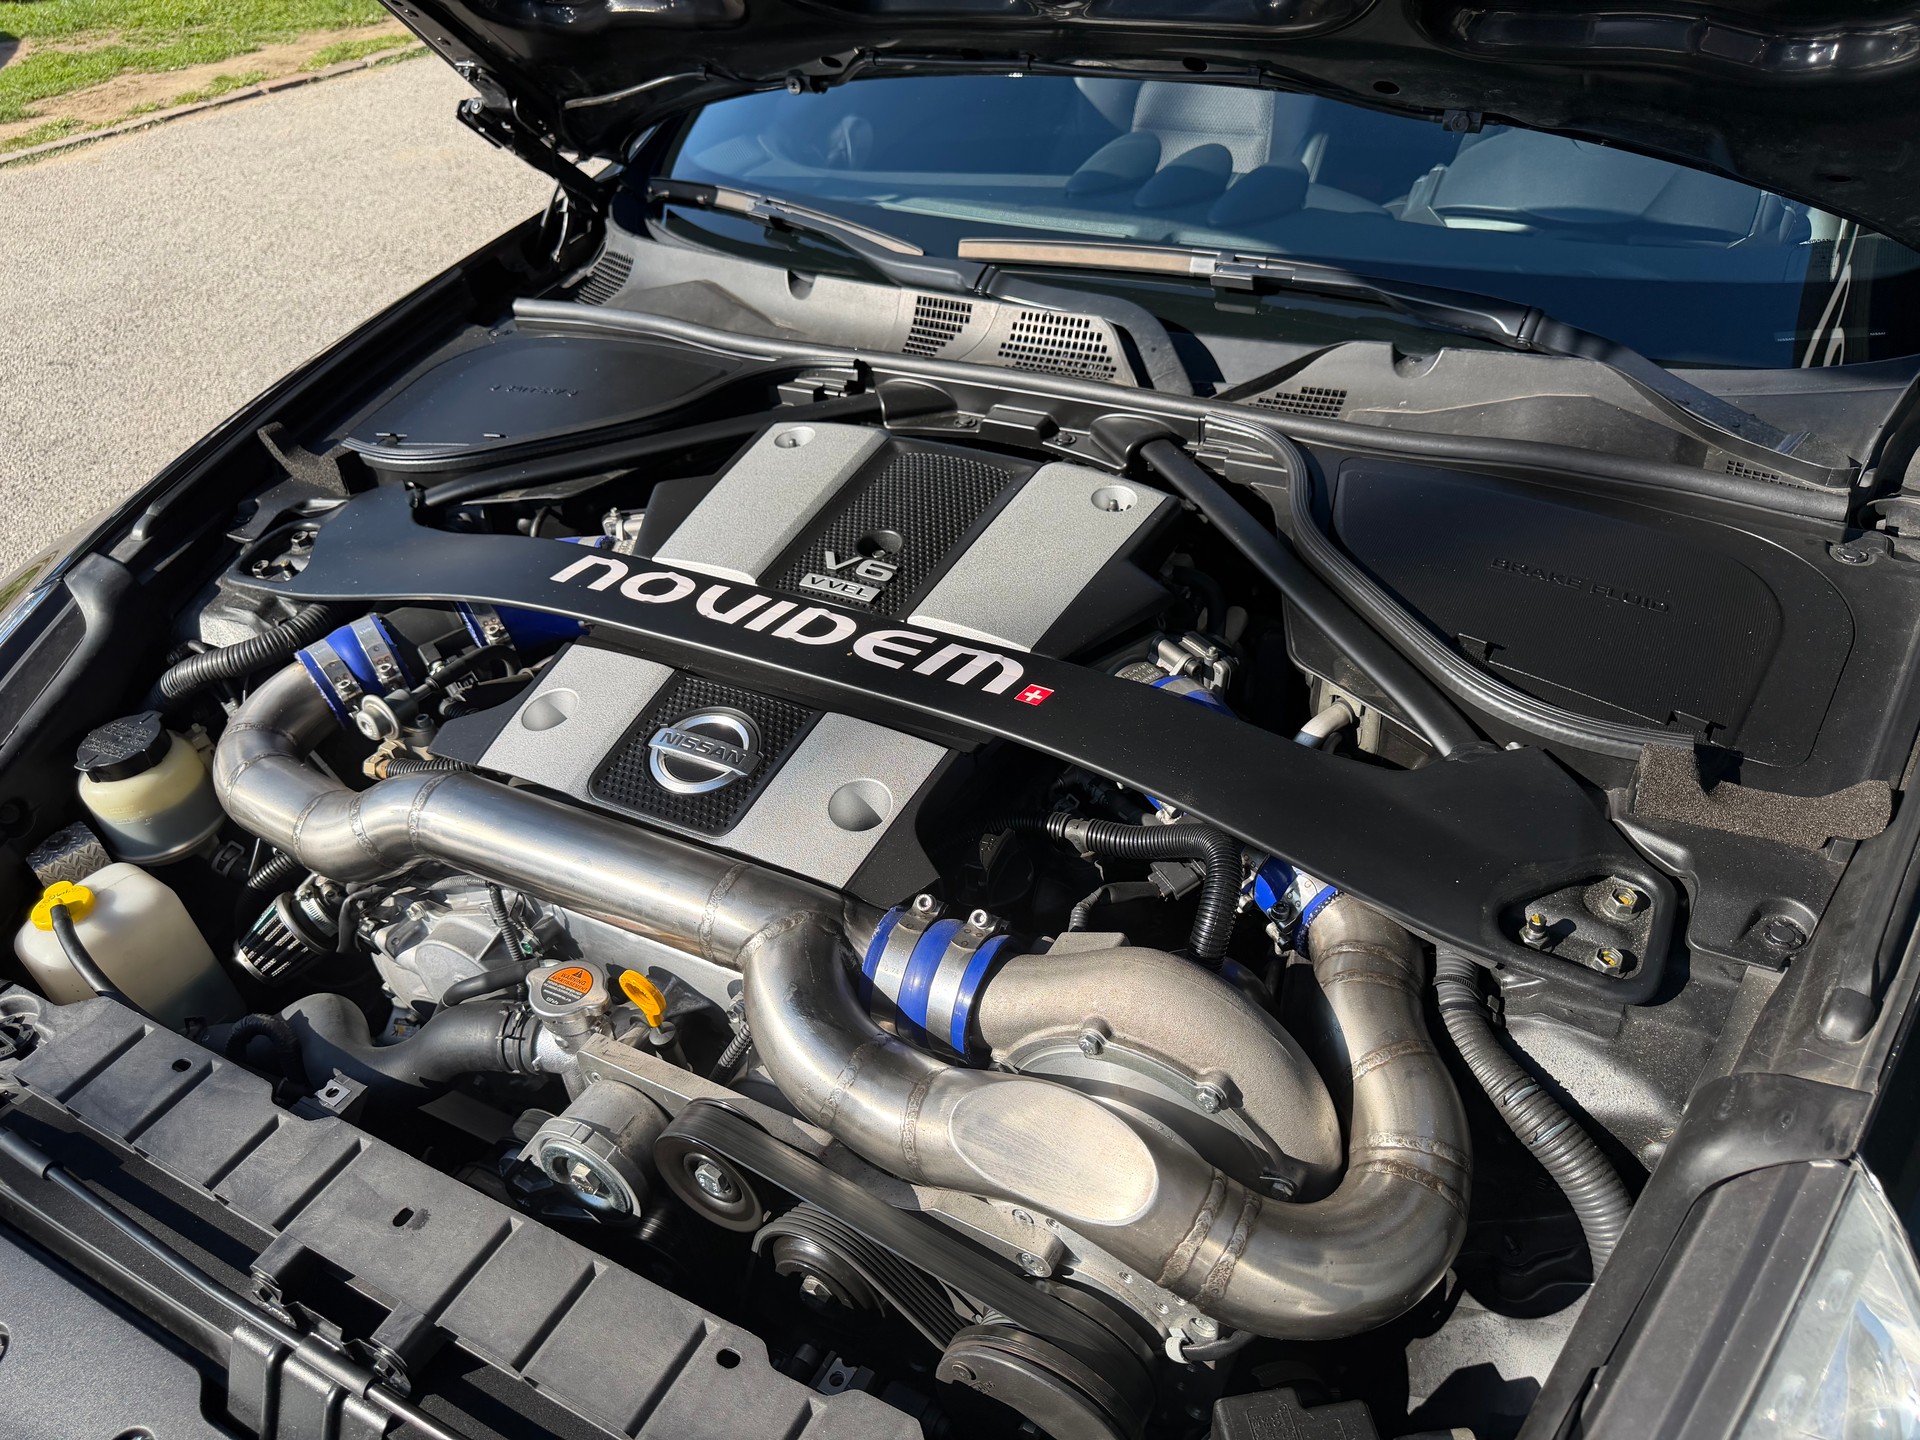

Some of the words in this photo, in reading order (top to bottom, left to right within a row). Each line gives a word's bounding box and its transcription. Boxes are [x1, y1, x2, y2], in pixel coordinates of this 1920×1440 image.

[824, 550, 898, 582] V6
[811, 575, 869, 599] VVEL
[1490, 557, 1583, 591] BRAKE
[1589, 582, 1670, 614] FLUID
[659, 730, 747, 767] NISSAN
